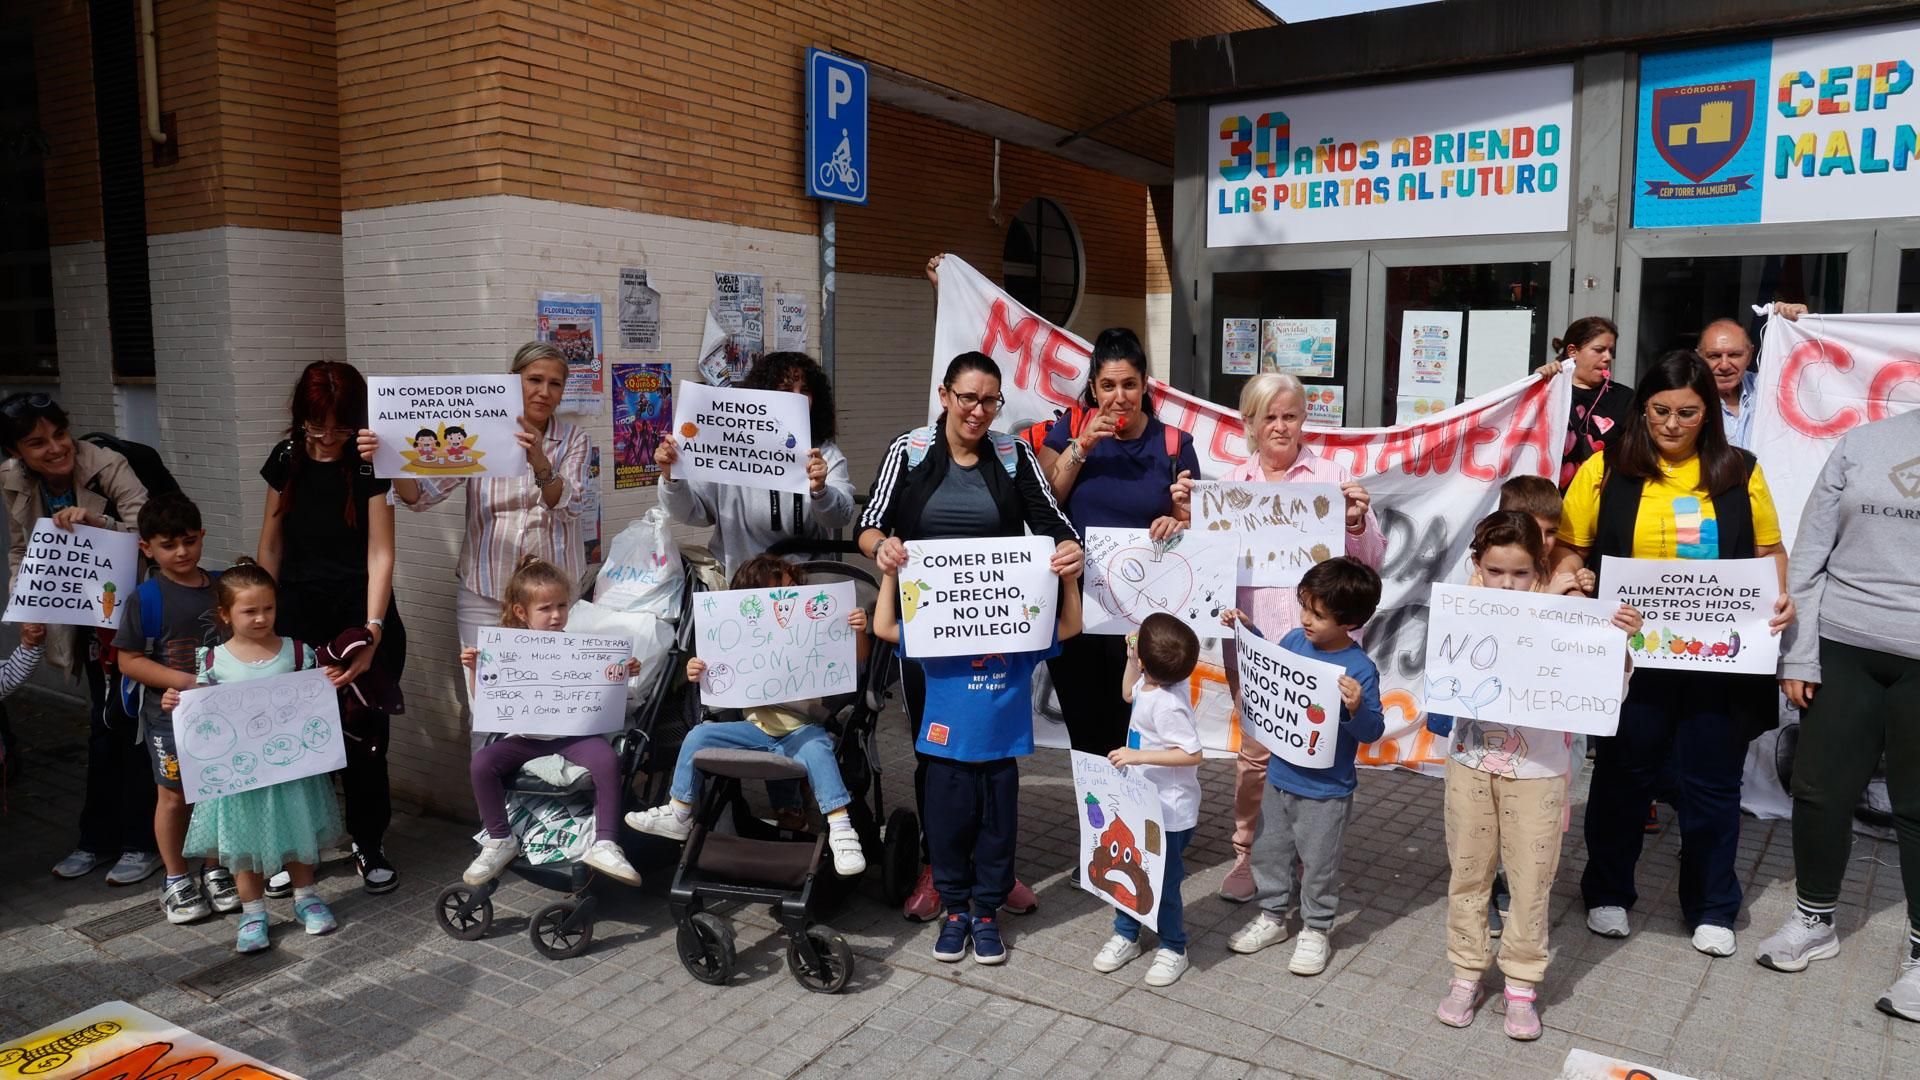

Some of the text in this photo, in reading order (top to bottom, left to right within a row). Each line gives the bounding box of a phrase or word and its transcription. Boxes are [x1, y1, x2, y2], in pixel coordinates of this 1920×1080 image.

[828, 66, 853, 120] P
[1680, 84, 1727, 96] CÓRDOBA
[1777, 60, 1914, 118] CEIP
[1219, 111, 1561, 182] 30 AÑOS ABRIENDO
[1218, 162, 1558, 215] LAS PUERTAS AL FUTURO
[1660, 184, 1737, 197] CEIP TORRE MALMUERTA
[715, 275, 740, 284] VUELTA
[724, 285, 740, 293] COLE
[777, 298, 784, 306] YO
[378, 385, 506, 397] UN COMEDOR DIGNO
[411, 397, 474, 408] PARA UNA
[712, 400, 767, 416] MENOS
[378, 407, 508, 420] ALIMENTACIÓN SANA
[696, 413, 779, 434] RECORTES,
[722, 431, 755, 445] MÁS
[682, 441, 796, 463] ALIMENTACIÓN
[694, 457, 785, 476] DE CALIDAD
[1861, 504, 1879, 515] EL
[33, 532, 93, 549] CON LA
[67, 550, 90, 564] DE
[95, 556, 113, 569] LA
[923, 551, 1032, 568] COMER BIEN
[954, 570, 1004, 584] ES UN
[1661, 574, 1719, 584] CON LA
[30, 580, 83, 593] NO SE
[1617, 585, 1760, 597] ALIMENTACIÓN DE
[936, 586, 1025, 603] DERECHO,
[15, 595, 94, 610] NEGOCIA
[1705, 600, 1755, 612] HIJOS,
[953, 605, 1009, 620] NO UN
[1440, 593, 1612, 628] PESCADO RECALENTAD
[1663, 611, 1681, 621] SE
[1685, 612, 1736, 623] JUEGA
[707, 619, 741, 652] NO
[785, 618, 854, 648] JUEGA
[933, 621, 1031, 639] PRIVILEGIO
[514, 634, 556, 644] COMIDA
[563, 638, 576, 646] DE
[571, 653, 612, 661] NOMBRE
[1439, 633, 1606, 671] NO ES COMIDA
[507, 669, 539, 680] POCO
[1537, 666, 1563, 678] DE
[745, 662, 852, 700] COMIDA
[1241, 662, 1312, 709] NIÑOS NO
[534, 691, 543, 699] A
[1509, 686, 1620, 715] MERCADO
[497, 705, 602, 716] NO A COMIDA DE CASA
[1244, 684, 1298, 727] SON UN
